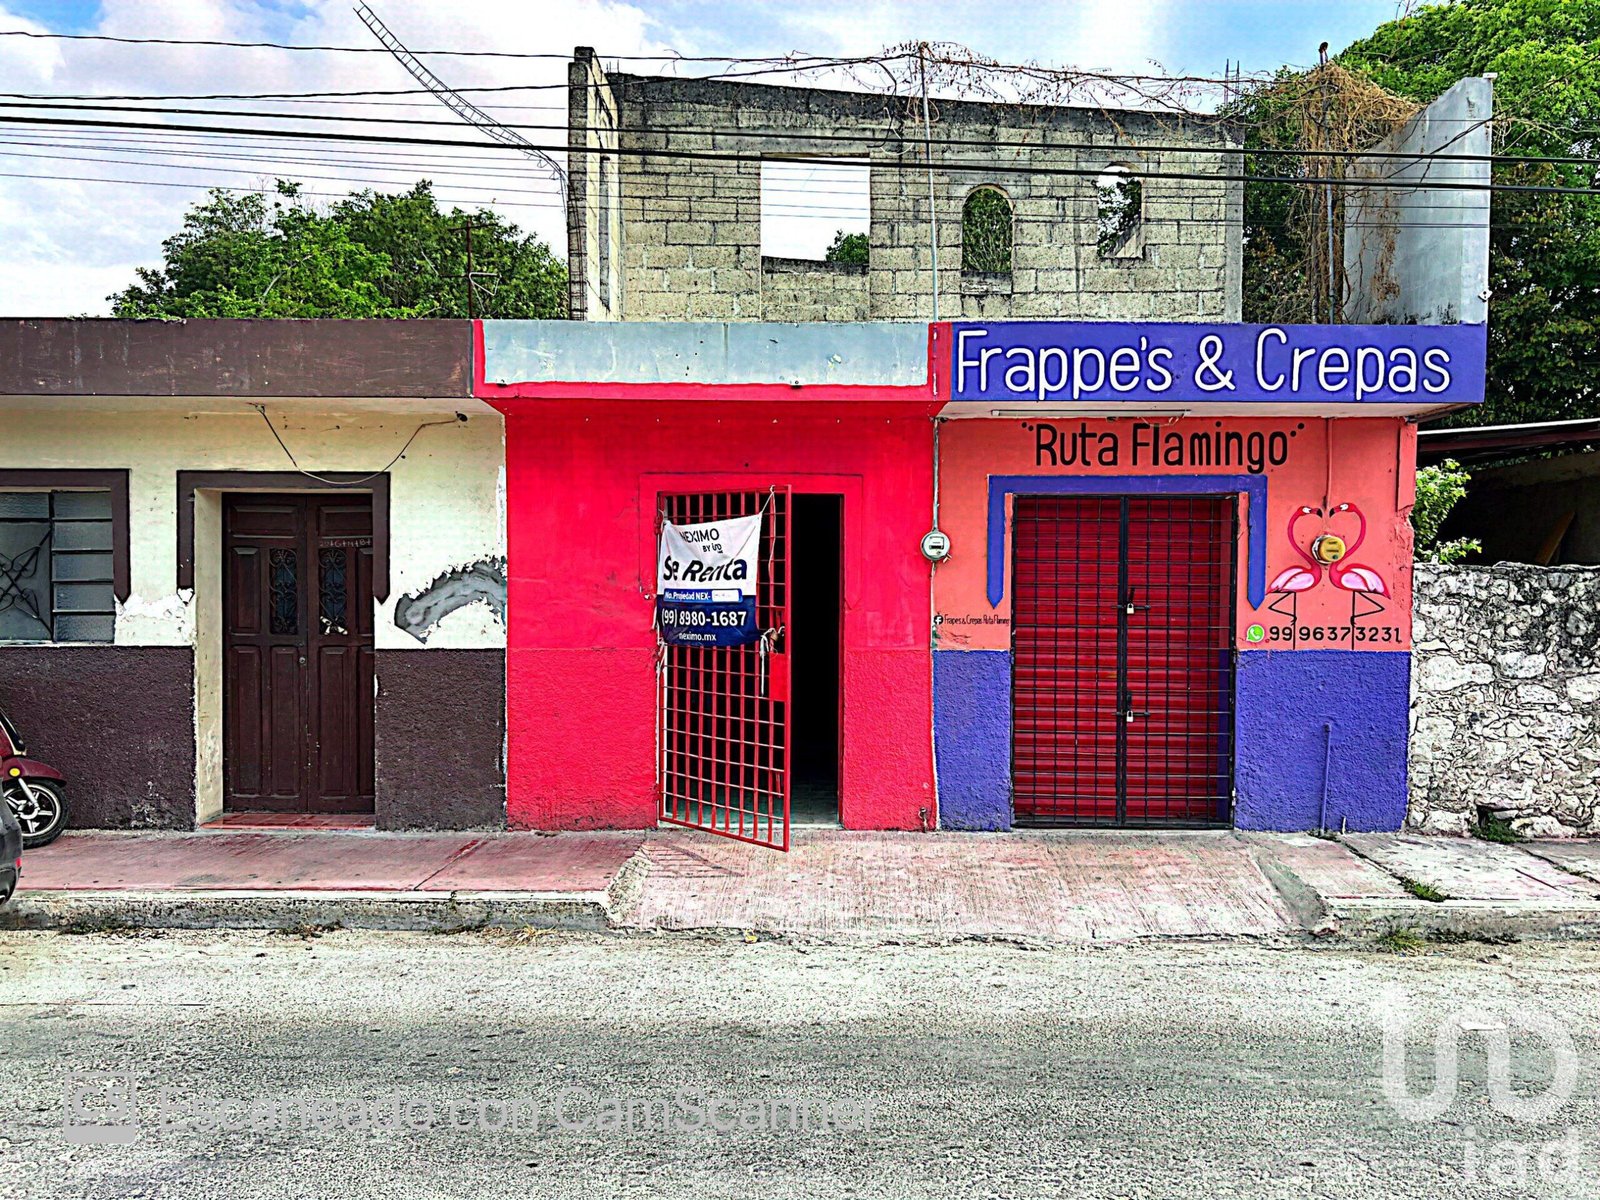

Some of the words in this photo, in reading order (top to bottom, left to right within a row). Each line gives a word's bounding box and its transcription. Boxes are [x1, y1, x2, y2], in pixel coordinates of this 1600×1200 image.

[958, 329, 1173, 400] Frappe's
[1194, 335, 1236, 391] &
[1256, 328, 1451, 400] Crepas
[702, 545, 711, 553] BY
[663, 555, 680, 581] Se
[682, 558, 748, 582] Renta
[661, 608, 678, 628] (99)
[679, 610, 747, 627] 8980-1687
[678, 631, 717, 642] neximo.mx
